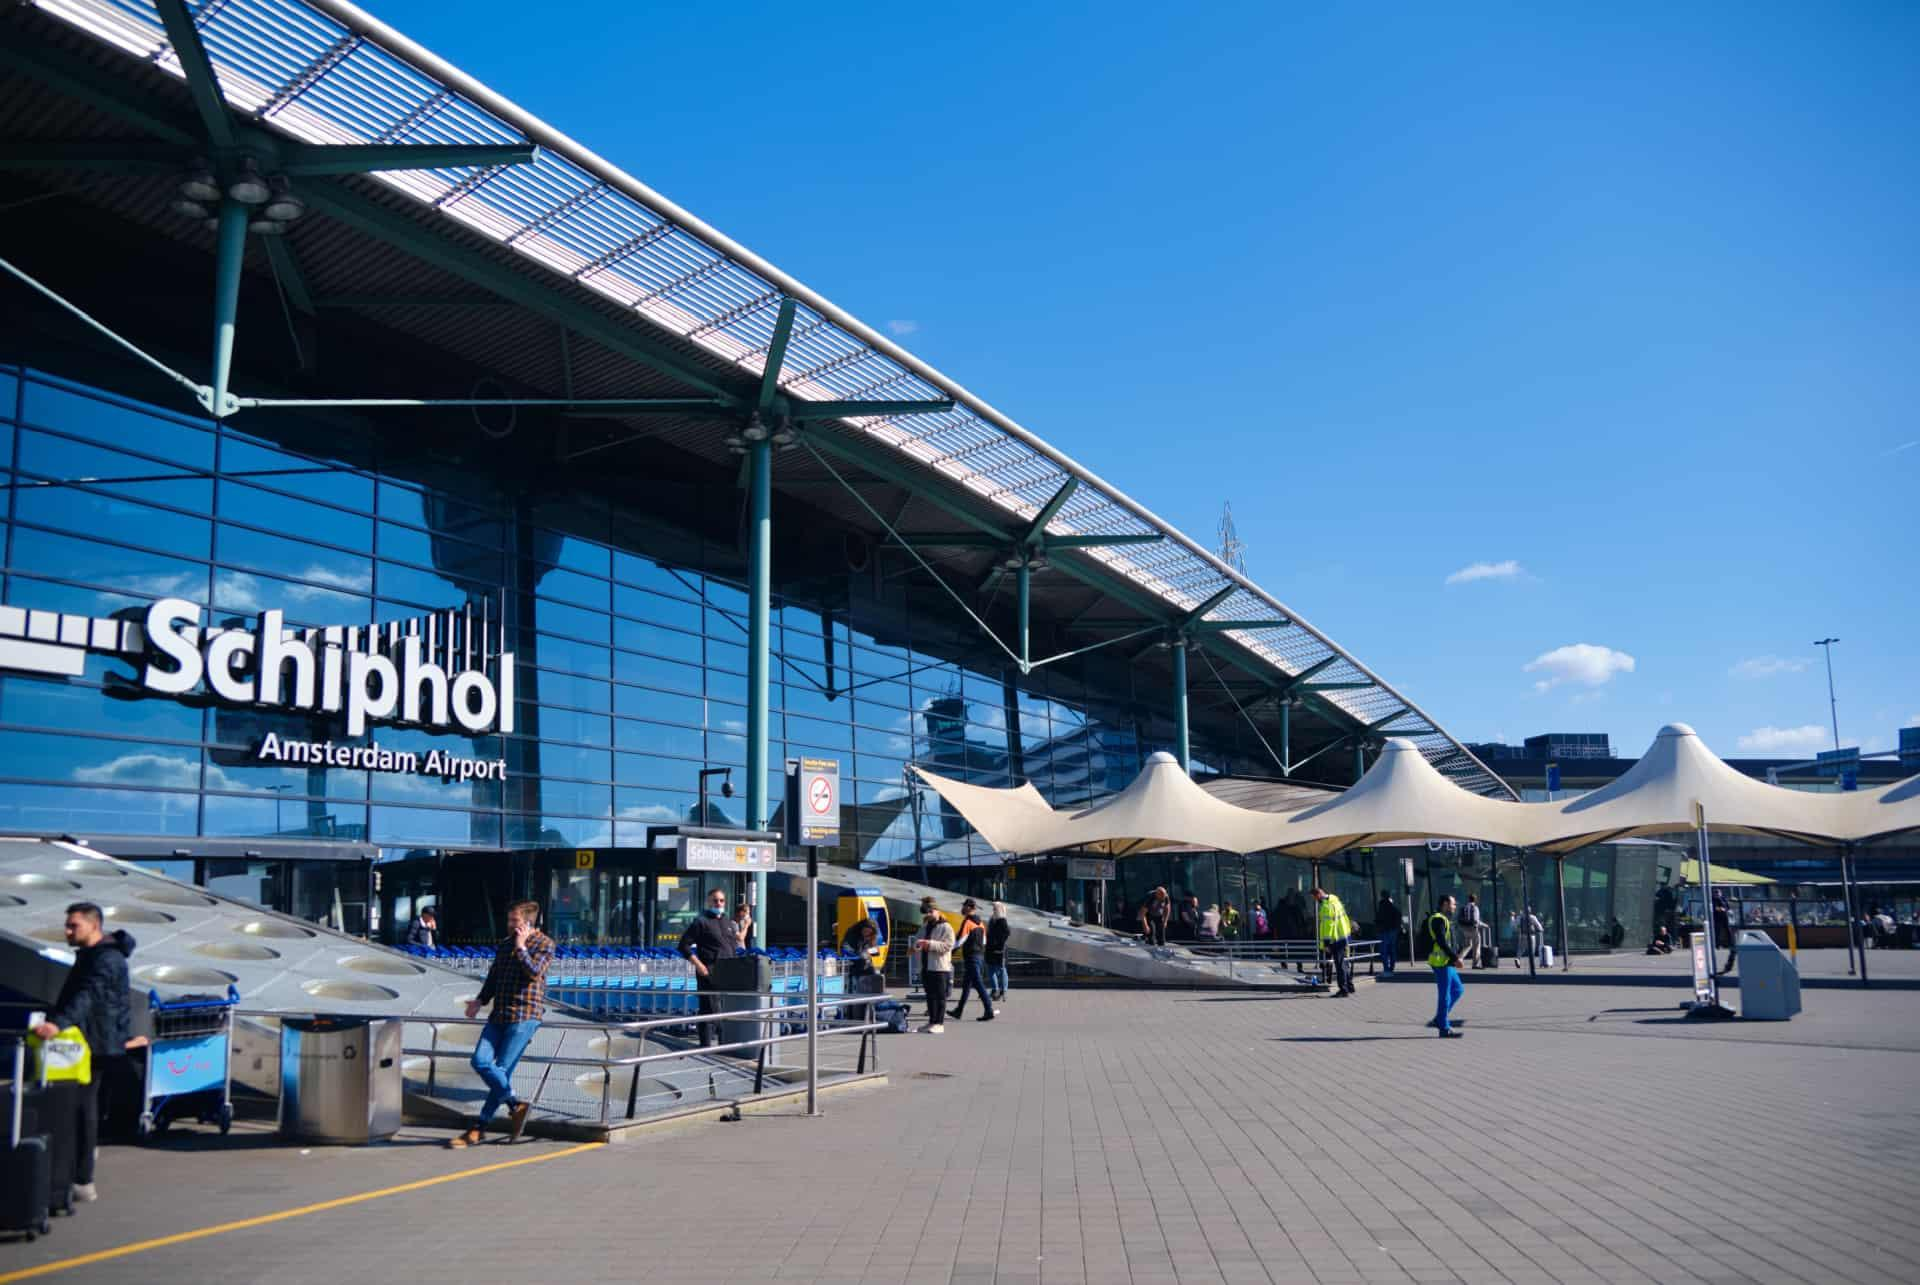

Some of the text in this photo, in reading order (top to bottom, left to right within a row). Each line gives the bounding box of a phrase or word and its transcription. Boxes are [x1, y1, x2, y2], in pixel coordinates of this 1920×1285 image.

[144, 597, 514, 736] Schiphol
[260, 732, 507, 783] Amsterdam Airport
[579, 852, 591, 867] D
